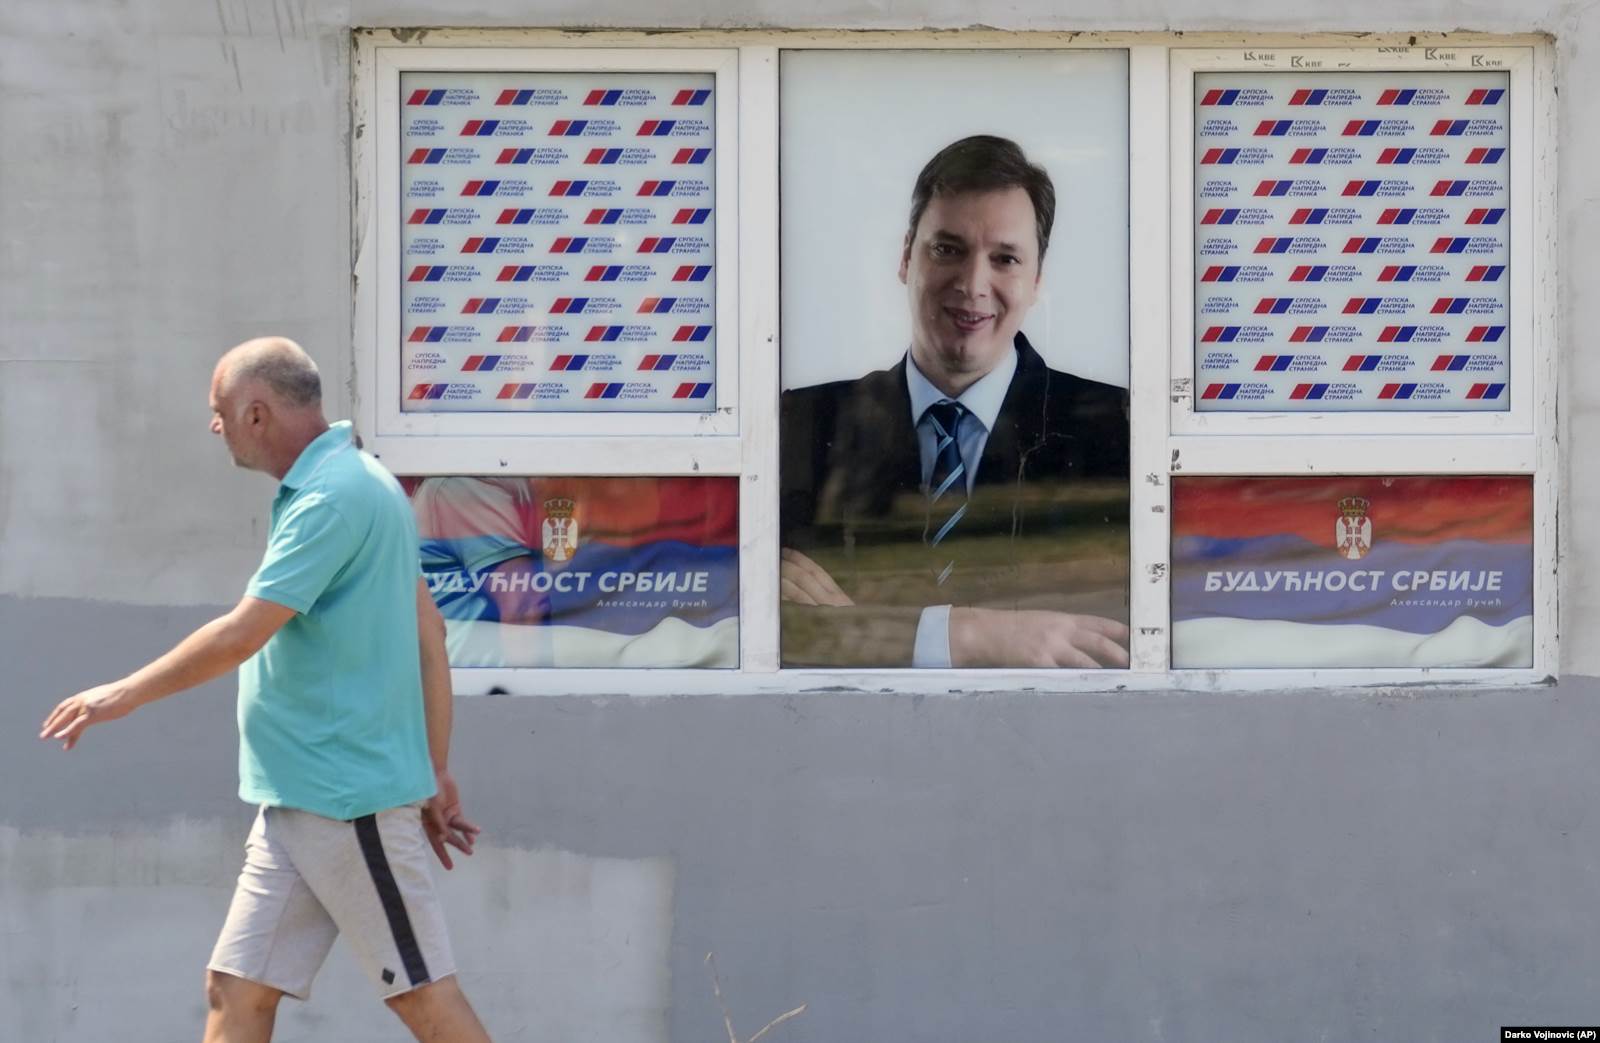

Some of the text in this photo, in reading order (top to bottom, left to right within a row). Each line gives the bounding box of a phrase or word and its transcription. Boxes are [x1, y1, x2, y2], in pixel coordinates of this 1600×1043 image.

[422, 571, 709, 593] УДУЋНОСТ СРБИЈЕ
[1204, 570, 1503, 593] БУДУЋНОСТ СРБИЈЕ
[597, 599, 708, 608] Александар Вучић
[1390, 598, 1502, 608] Александар Вучић
